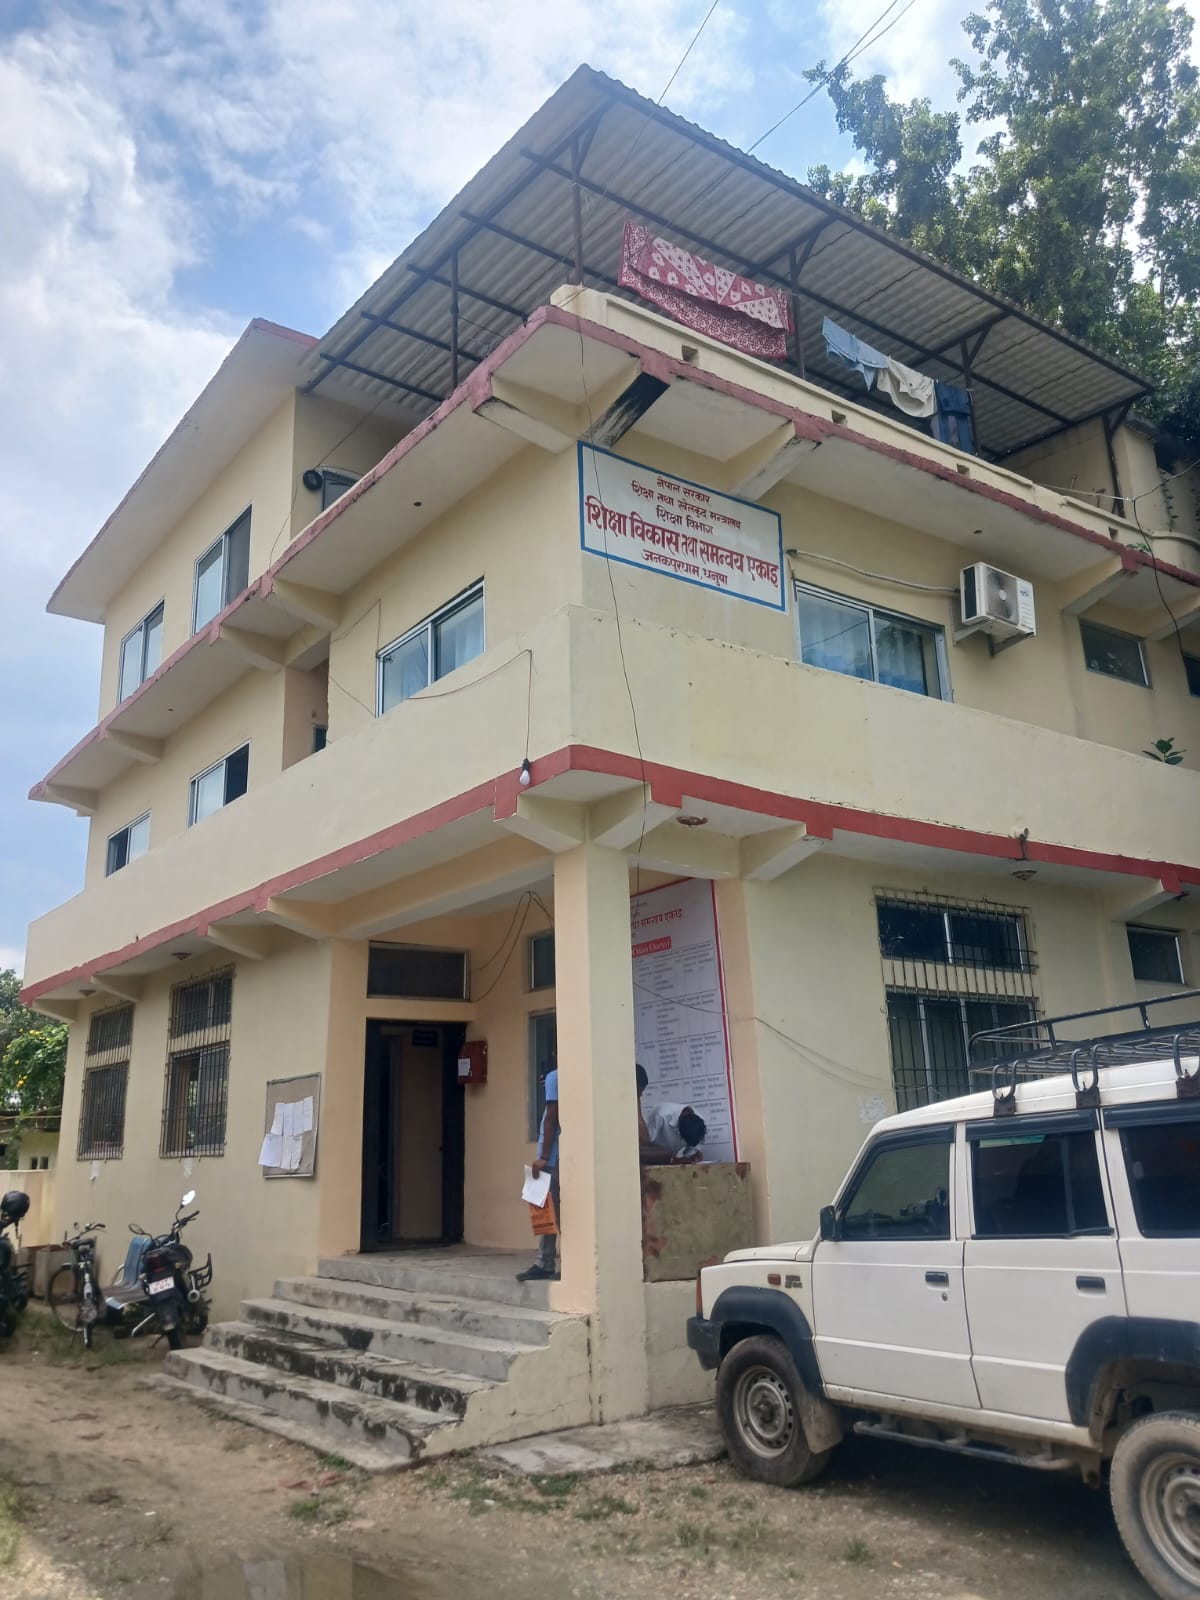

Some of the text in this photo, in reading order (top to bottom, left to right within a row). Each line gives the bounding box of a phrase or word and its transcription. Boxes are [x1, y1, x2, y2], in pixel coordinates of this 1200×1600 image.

[631, 480, 654, 500] शिक्षा
[657, 493, 674, 506] तथा
[656, 476, 711, 506] नेपाल सरकार
[585, 495, 628, 538] शिक्षा
[629, 511, 681, 557] विकास
[681, 533, 698, 559] तथा
[699, 540, 745, 574] समन्वय
[656, 504, 714, 535] शिक्षा विभाग
